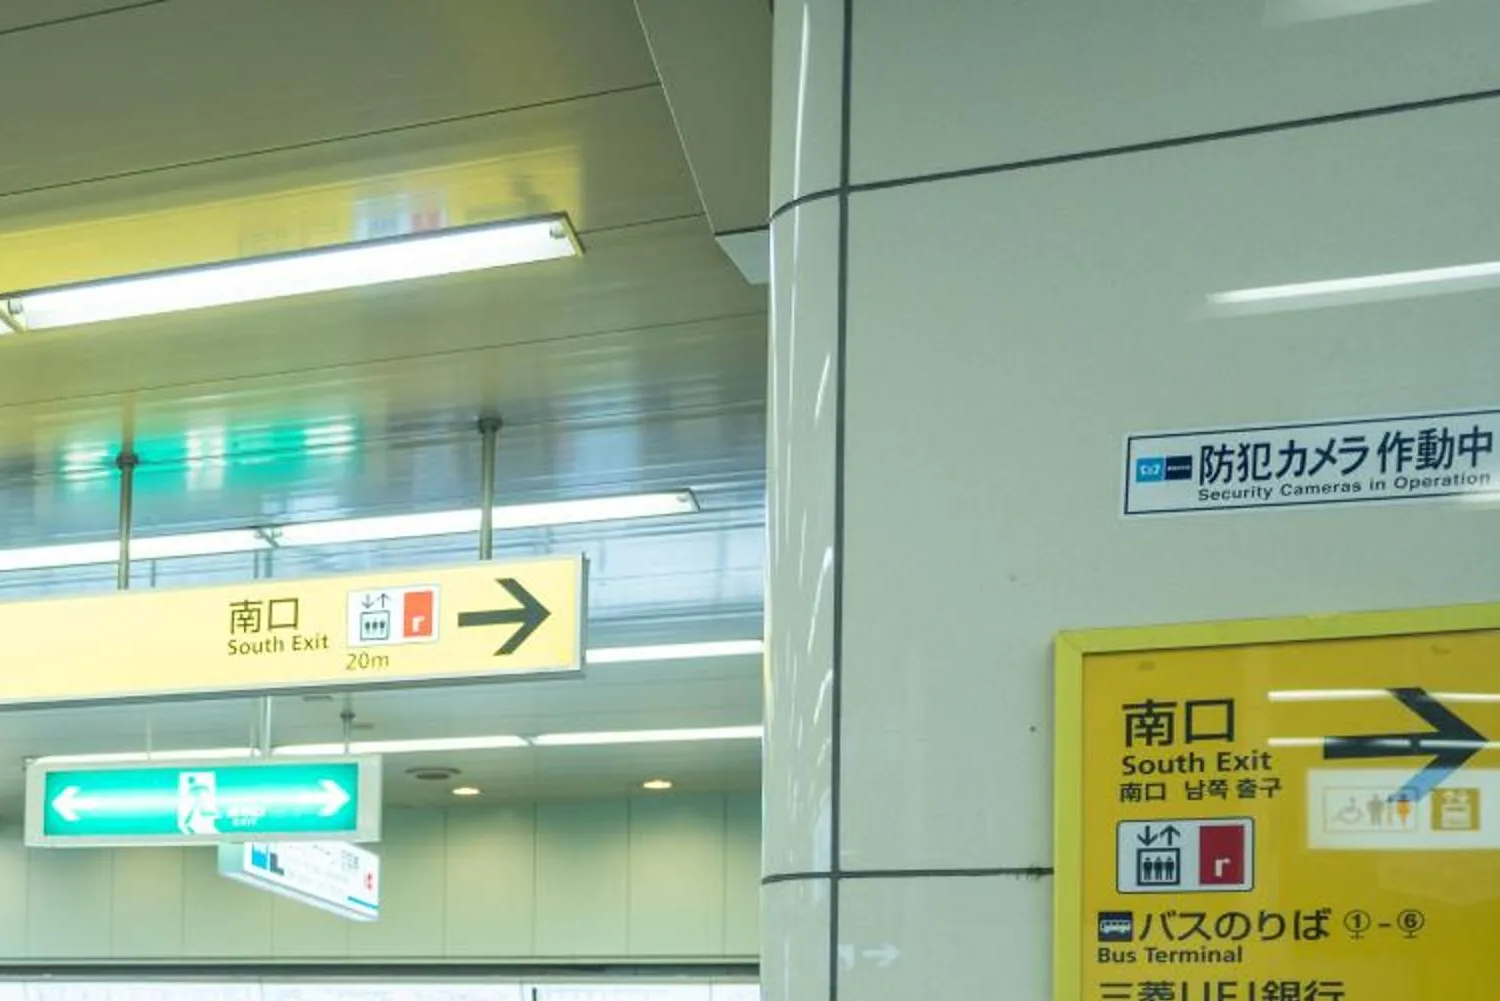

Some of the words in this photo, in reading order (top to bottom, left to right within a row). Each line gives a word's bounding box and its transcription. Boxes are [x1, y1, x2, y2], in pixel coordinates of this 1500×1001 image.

[1200, 425, 1493, 485] 防犯カメラ作動中
[1198, 485, 1273, 502] Security
[1281, 481, 1361, 498] Cameras
[1369, 478, 1386, 491] in
[1394, 472, 1491, 493] Operation
[229, 597, 299, 635] 南口
[228, 636, 285, 656] South
[292, 633, 329, 652] Exit
[346, 652, 389, 672] 20m
[1122, 698, 1235, 748] 南口
[1122, 754, 1204, 776] South
[1217, 751, 1272, 772] Exit
[1119, 781, 1166, 803] 南口
[1185, 780, 1229, 801] 남쪽
[1237, 777, 1282, 799] 출구
[1140, 908, 1331, 942] バスのりば
[1097, 946, 1137, 964] Bus
[1146, 945, 1242, 964] Terminal
